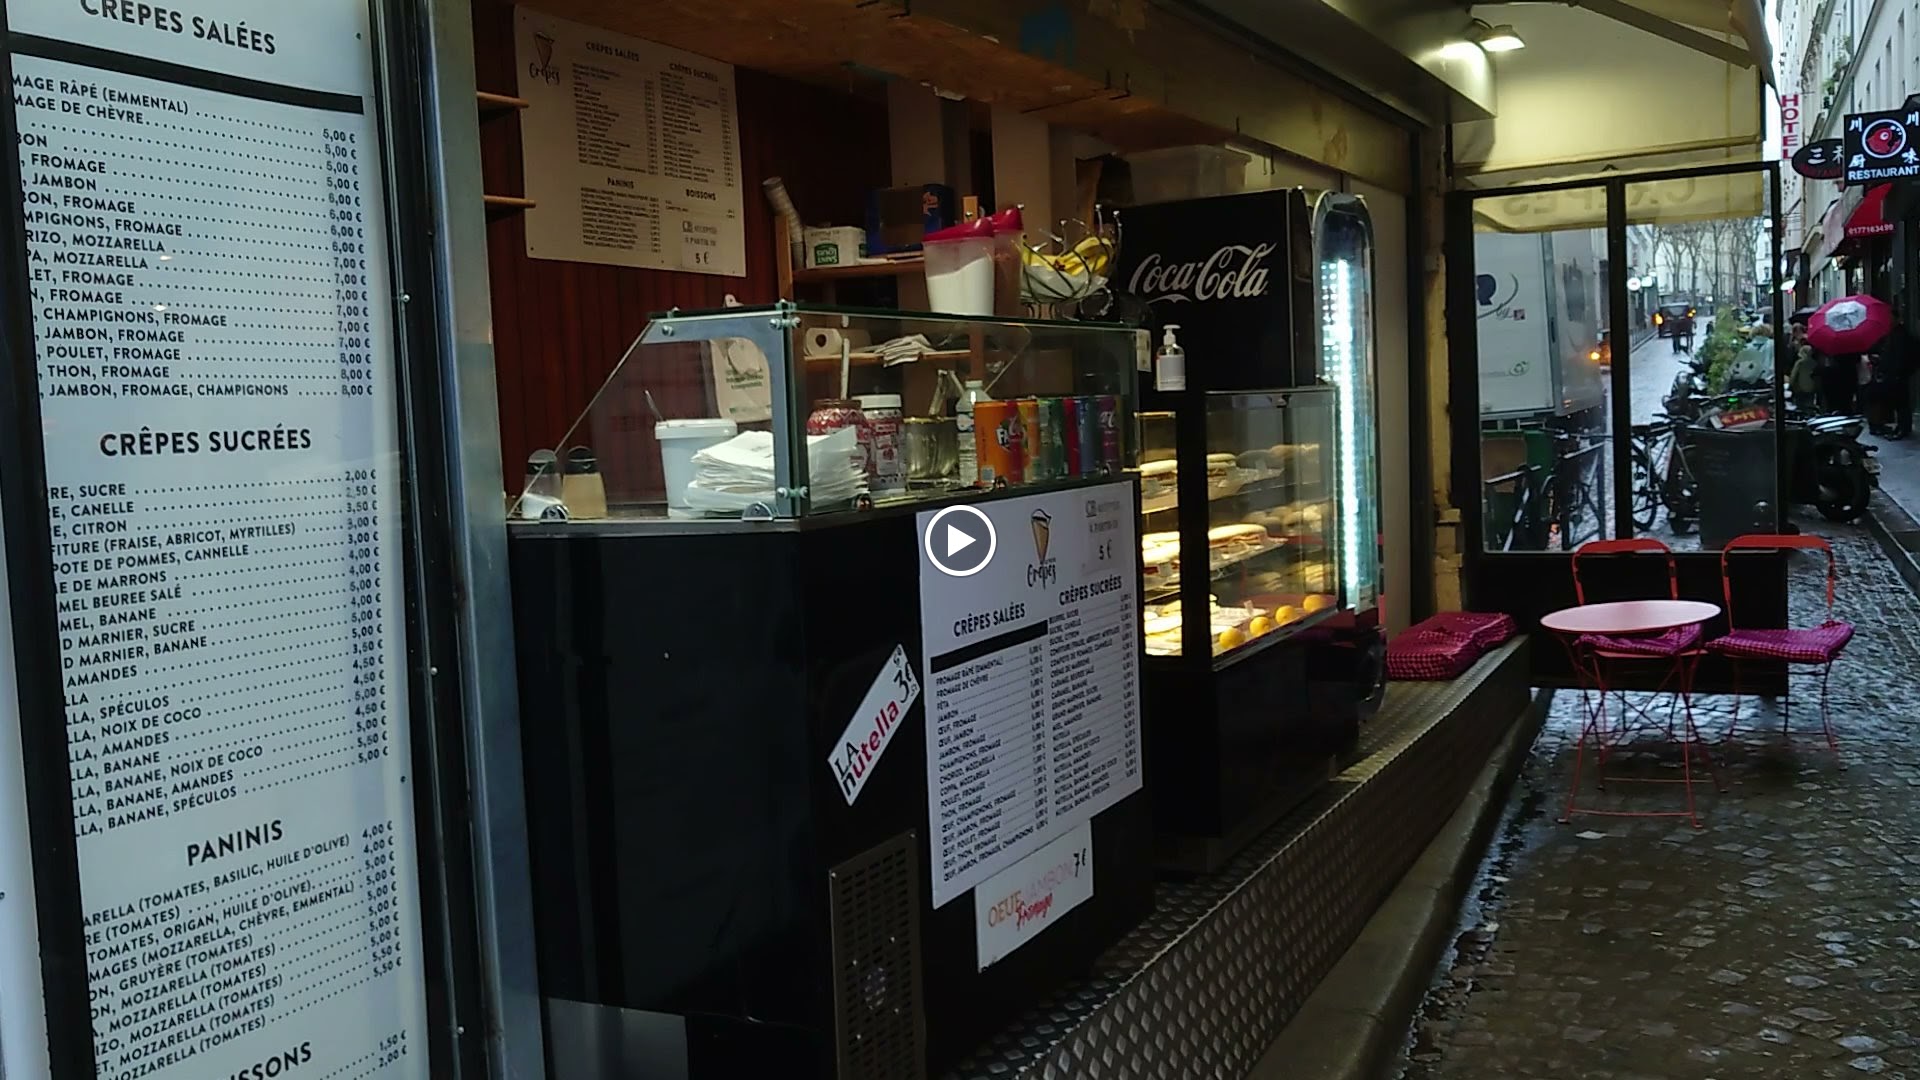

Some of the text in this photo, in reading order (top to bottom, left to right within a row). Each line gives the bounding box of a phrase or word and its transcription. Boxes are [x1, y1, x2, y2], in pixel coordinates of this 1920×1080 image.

[192, 21, 276, 54] SALÉES
[60, 80, 97, 99] RÂPÉ
[103, 87, 188, 115] (EMMENTAL)
[323, 128, 346, 142] 5,00
[61, 100, 143, 124] DE CHÈVRE
[1782, 94, 1799, 159] HOTEL
[31, 153, 106, 174] FROMAGE
[1848, 166, 1919, 181] RESTAURANT
[32, 173, 96, 191] JAMBON
[686, 189, 717, 201] BOISSONS
[63, 195, 135, 213] FROMAGE
[115, 219, 182, 236] FROMAGE
[73, 234, 165, 253] MOZZARELLA
[54, 251, 148, 269] MOZZARELLA
[1128, 242, 1277, 304] Coca-Cola
[62, 270, 134, 286] FROMAGE
[50, 289, 123, 304] FROMAGE
[43, 308, 227, 327] CHAMPIGNONS, FROMAGE
[44, 326, 184, 343] JAMBON, FROMAGE
[47, 346, 180, 362] POULET, FROMAGE
[47, 365, 169, 380] THON, FROMAGE
[49, 384, 288, 399] JAMBON, FROMAGE, CHAMPIGNONS
[100, 423, 311, 456] CRÊPES SUCRÉES
[79, 483, 126, 497] SUCRE
[345, 470, 367, 483] 2,00
[71, 501, 134, 517] CANELLE
[72, 520, 127, 535] CITRON
[104, 522, 295, 553] (FRAISE, ABRICOT, MYRTILLES)
[94, 545, 249, 571] DE POMMES, CANNELLE
[73, 571, 166, 592] DE MARRONS
[93, 591, 145, 608] BEUREE
[150, 583, 181, 601] SALÉ
[1059, 575, 1122, 606] CRÊPES SUCRÉES
[99, 608, 156, 626] BANANE
[953, 602, 1026, 637] CRÊPES SALÉES
[79, 620, 195, 648] MARNIER, SUCRE
[80, 636, 207, 667] MARNIER, BANANE
[67, 665, 137, 688] AMANDES
[100, 695, 169, 719] SPÉCULOS
[353, 656, 375, 670] 4,50
[101, 707, 201, 738] NOIX DE COCO
[102, 731, 169, 756] AMANDES
[842, 701, 900, 797] nutella
[104, 751, 160, 774] BANANE
[105, 746, 262, 792] BANANE, NOIX DE COCO
[834, 741, 860, 780] LA
[107, 770, 233, 810] BANANE, AMANDES
[108, 786, 236, 829] BANANE, SPÉCULOS
[187, 820, 282, 867] PANINIS
[139, 881, 209, 912] (TOMATES,
[214, 864, 263, 887] BASILIC,
[267, 851, 300, 871] HUILE
[362, 824, 384, 839] 4,00
[89, 933, 159, 963] TOMATES,
[163, 913, 219, 939] ORIGAN,
[223, 898, 258, 920] HUILE
[106, 905, 180, 941] (TOMATES)
[142, 926, 235, 966] (MOZZARELLA,
[239, 906, 289, 930] CHÈVRE,
[293, 880, 354, 912] EMMENTAL)
[119, 934, 252, 990] GRUYÈRE (TOMATES)
[121, 942, 275, 1009] MOZZARELLA (TOMATES)
[109, 963, 266, 1032] MOZZARELLA (TOMATES)
[130, 973, 282, 1043] MOZZARELLA (TOMATES)
[120, 994, 274, 1066] MOZZARELLA (TOMATES)
[200, 1014, 265, 1053] (TOMATES)
